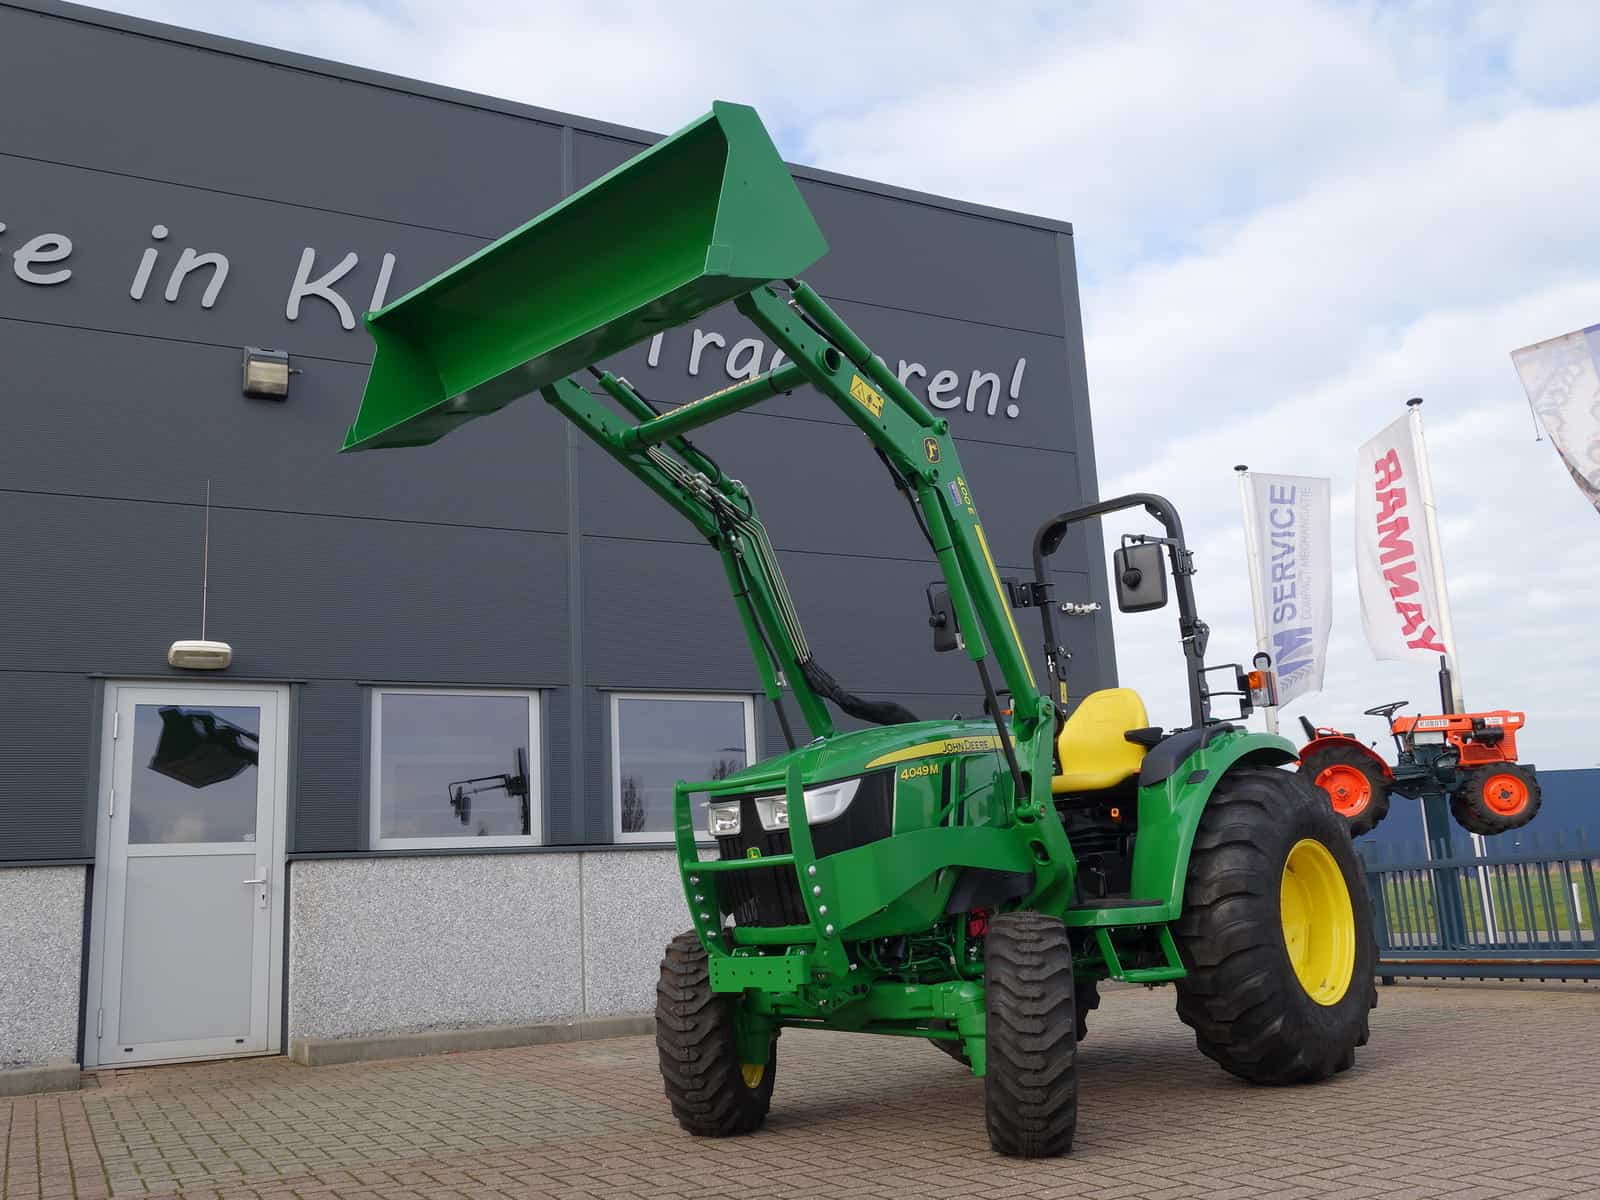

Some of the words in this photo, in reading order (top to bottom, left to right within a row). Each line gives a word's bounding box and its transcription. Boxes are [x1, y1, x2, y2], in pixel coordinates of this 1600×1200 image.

[129, 224, 230, 309] in
[647, 328, 1027, 418] raren!
[1270, 485, 1297, 625] SERVICE
[943, 741, 966, 753] JOHN
